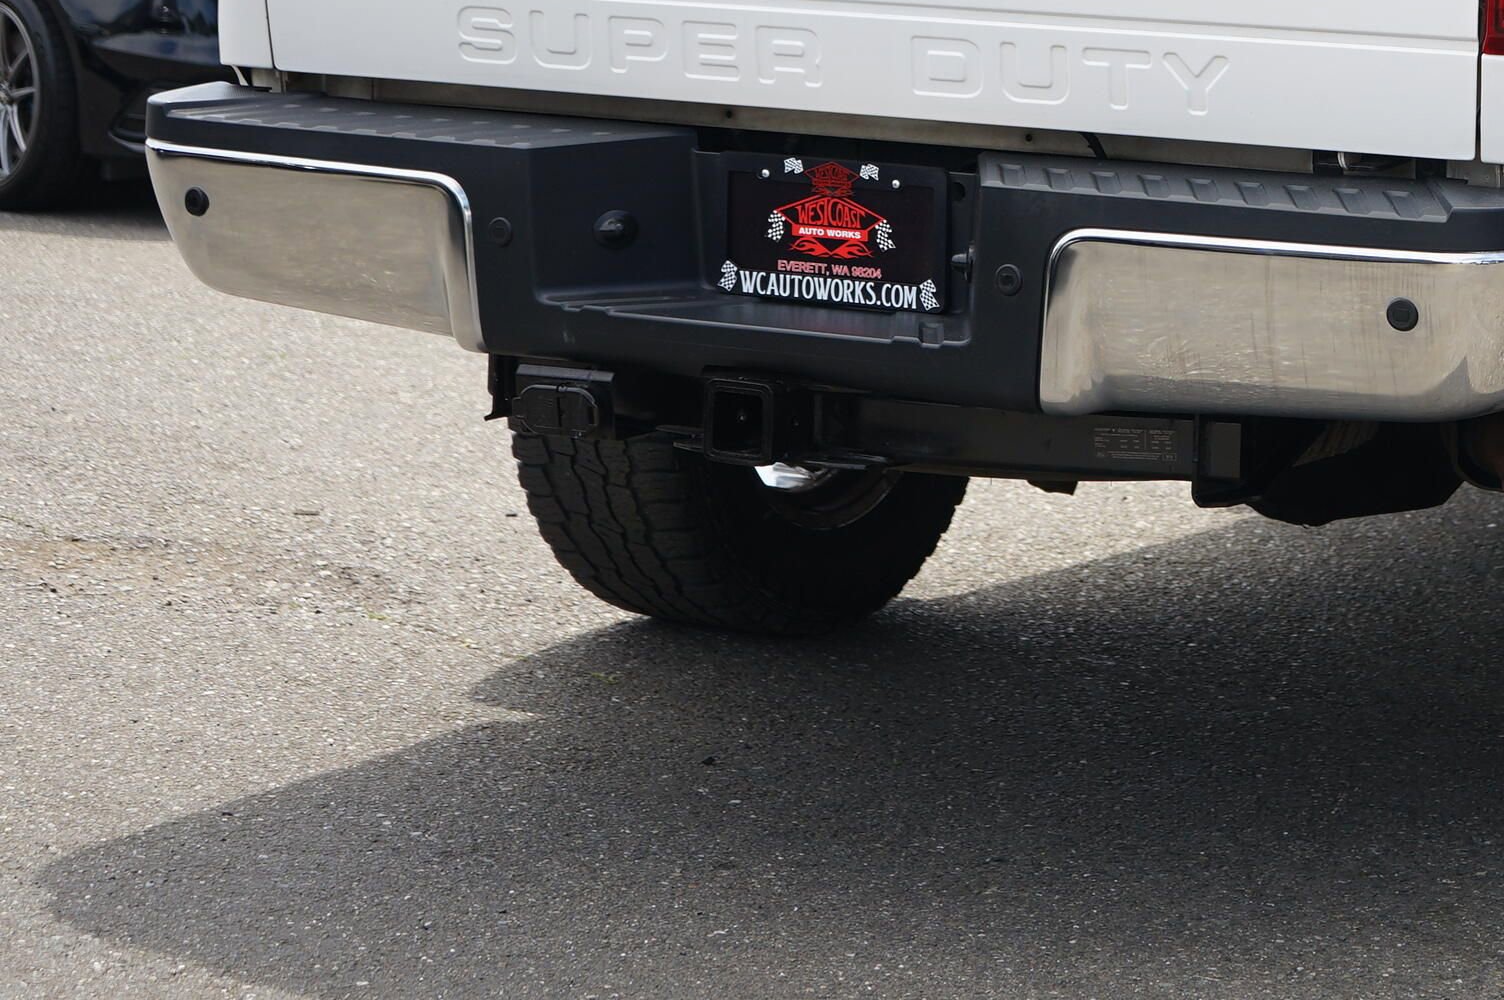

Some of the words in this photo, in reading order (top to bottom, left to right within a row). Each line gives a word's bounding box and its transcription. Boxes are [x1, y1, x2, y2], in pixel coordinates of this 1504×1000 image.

[457, 6, 823, 87] SUPER
[909, 34, 1230, 116] DUTY
[799, 227, 825, 236] AUTO
[826, 229, 861, 239] WORKS
[777, 260, 830, 276] EVERETT,
[831, 264, 850, 276] WA
[851, 266, 882, 279] 98204
[739, 270, 917, 309] WCAUTOWORKS.COM
